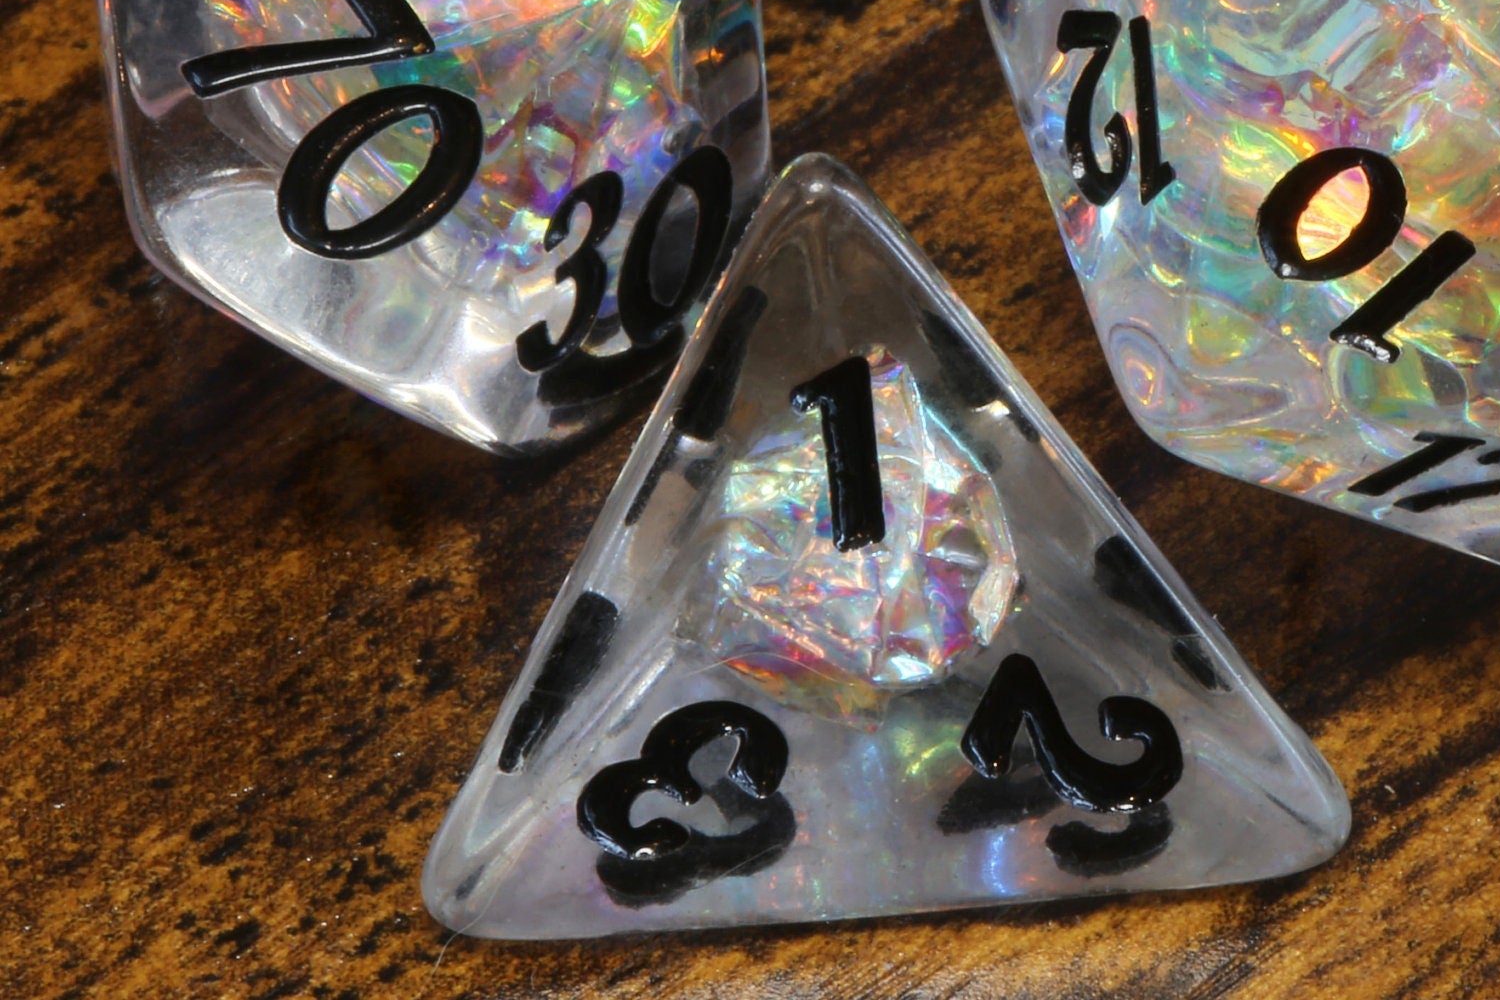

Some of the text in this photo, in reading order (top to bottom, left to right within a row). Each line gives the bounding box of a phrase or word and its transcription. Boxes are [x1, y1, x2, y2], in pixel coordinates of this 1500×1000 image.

[1057, 10, 1176, 206] 12
[516, 145, 732, 372] 30
[1256, 147, 1475, 363] 10
[789, 355, 885, 553] 1
[576, 700, 789, 860] 3
[960, 654, 1183, 813] 2
